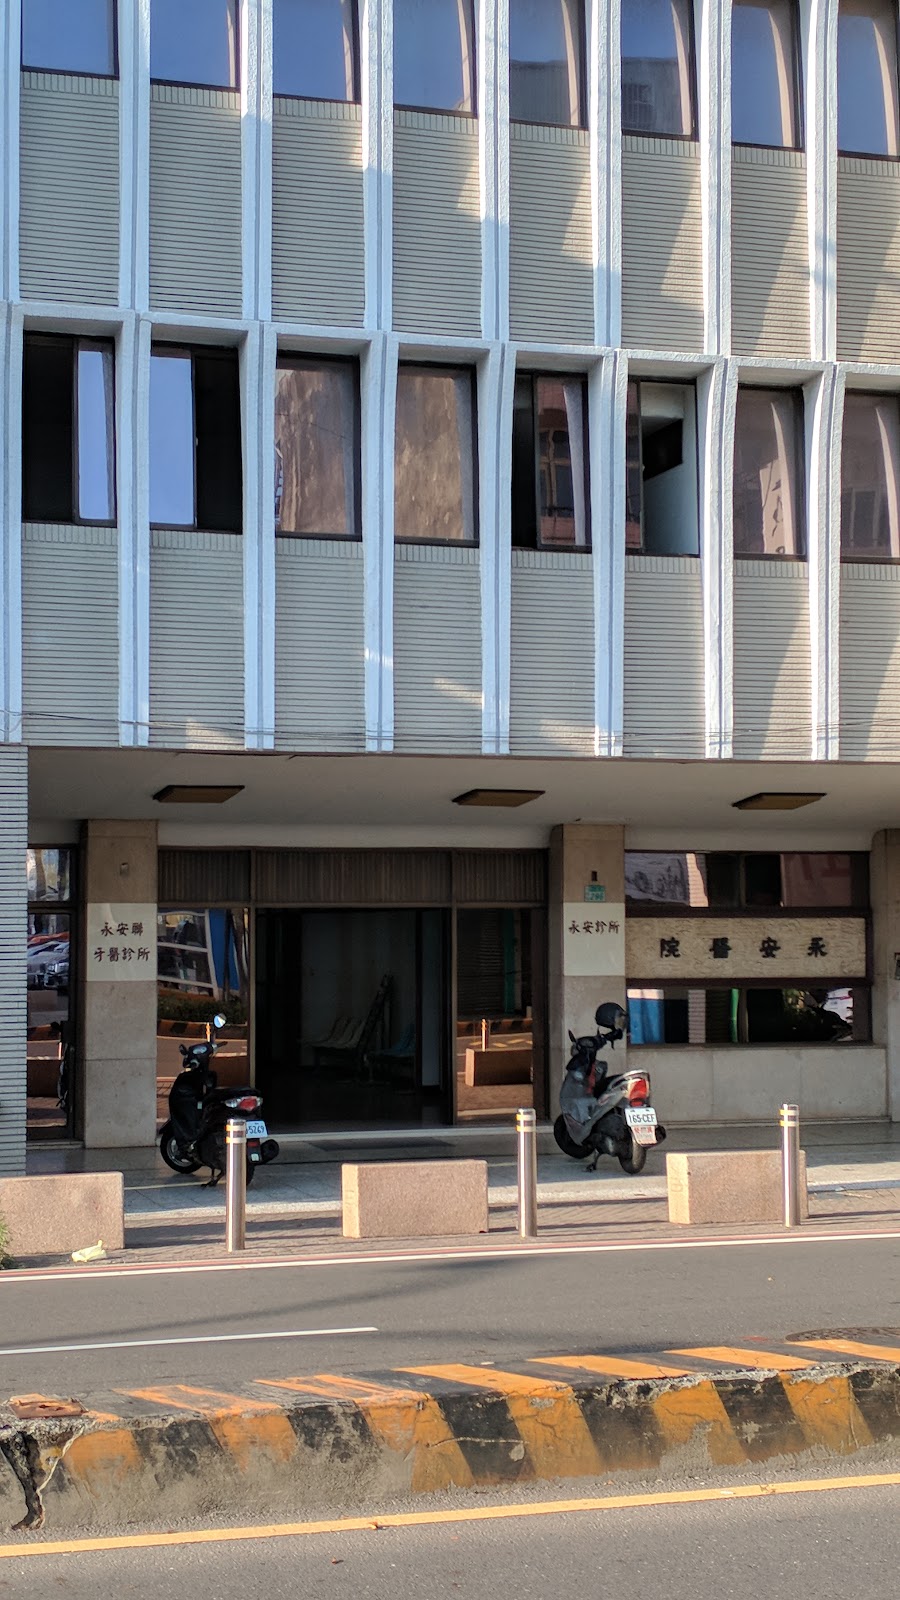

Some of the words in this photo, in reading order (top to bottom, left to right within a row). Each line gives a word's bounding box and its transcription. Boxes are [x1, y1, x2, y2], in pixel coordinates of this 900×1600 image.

[568, 920, 620, 935] 永安診所
[93, 946, 151, 962] 牙醫診所
[628, 1113, 655, 1124] 165-CEF
